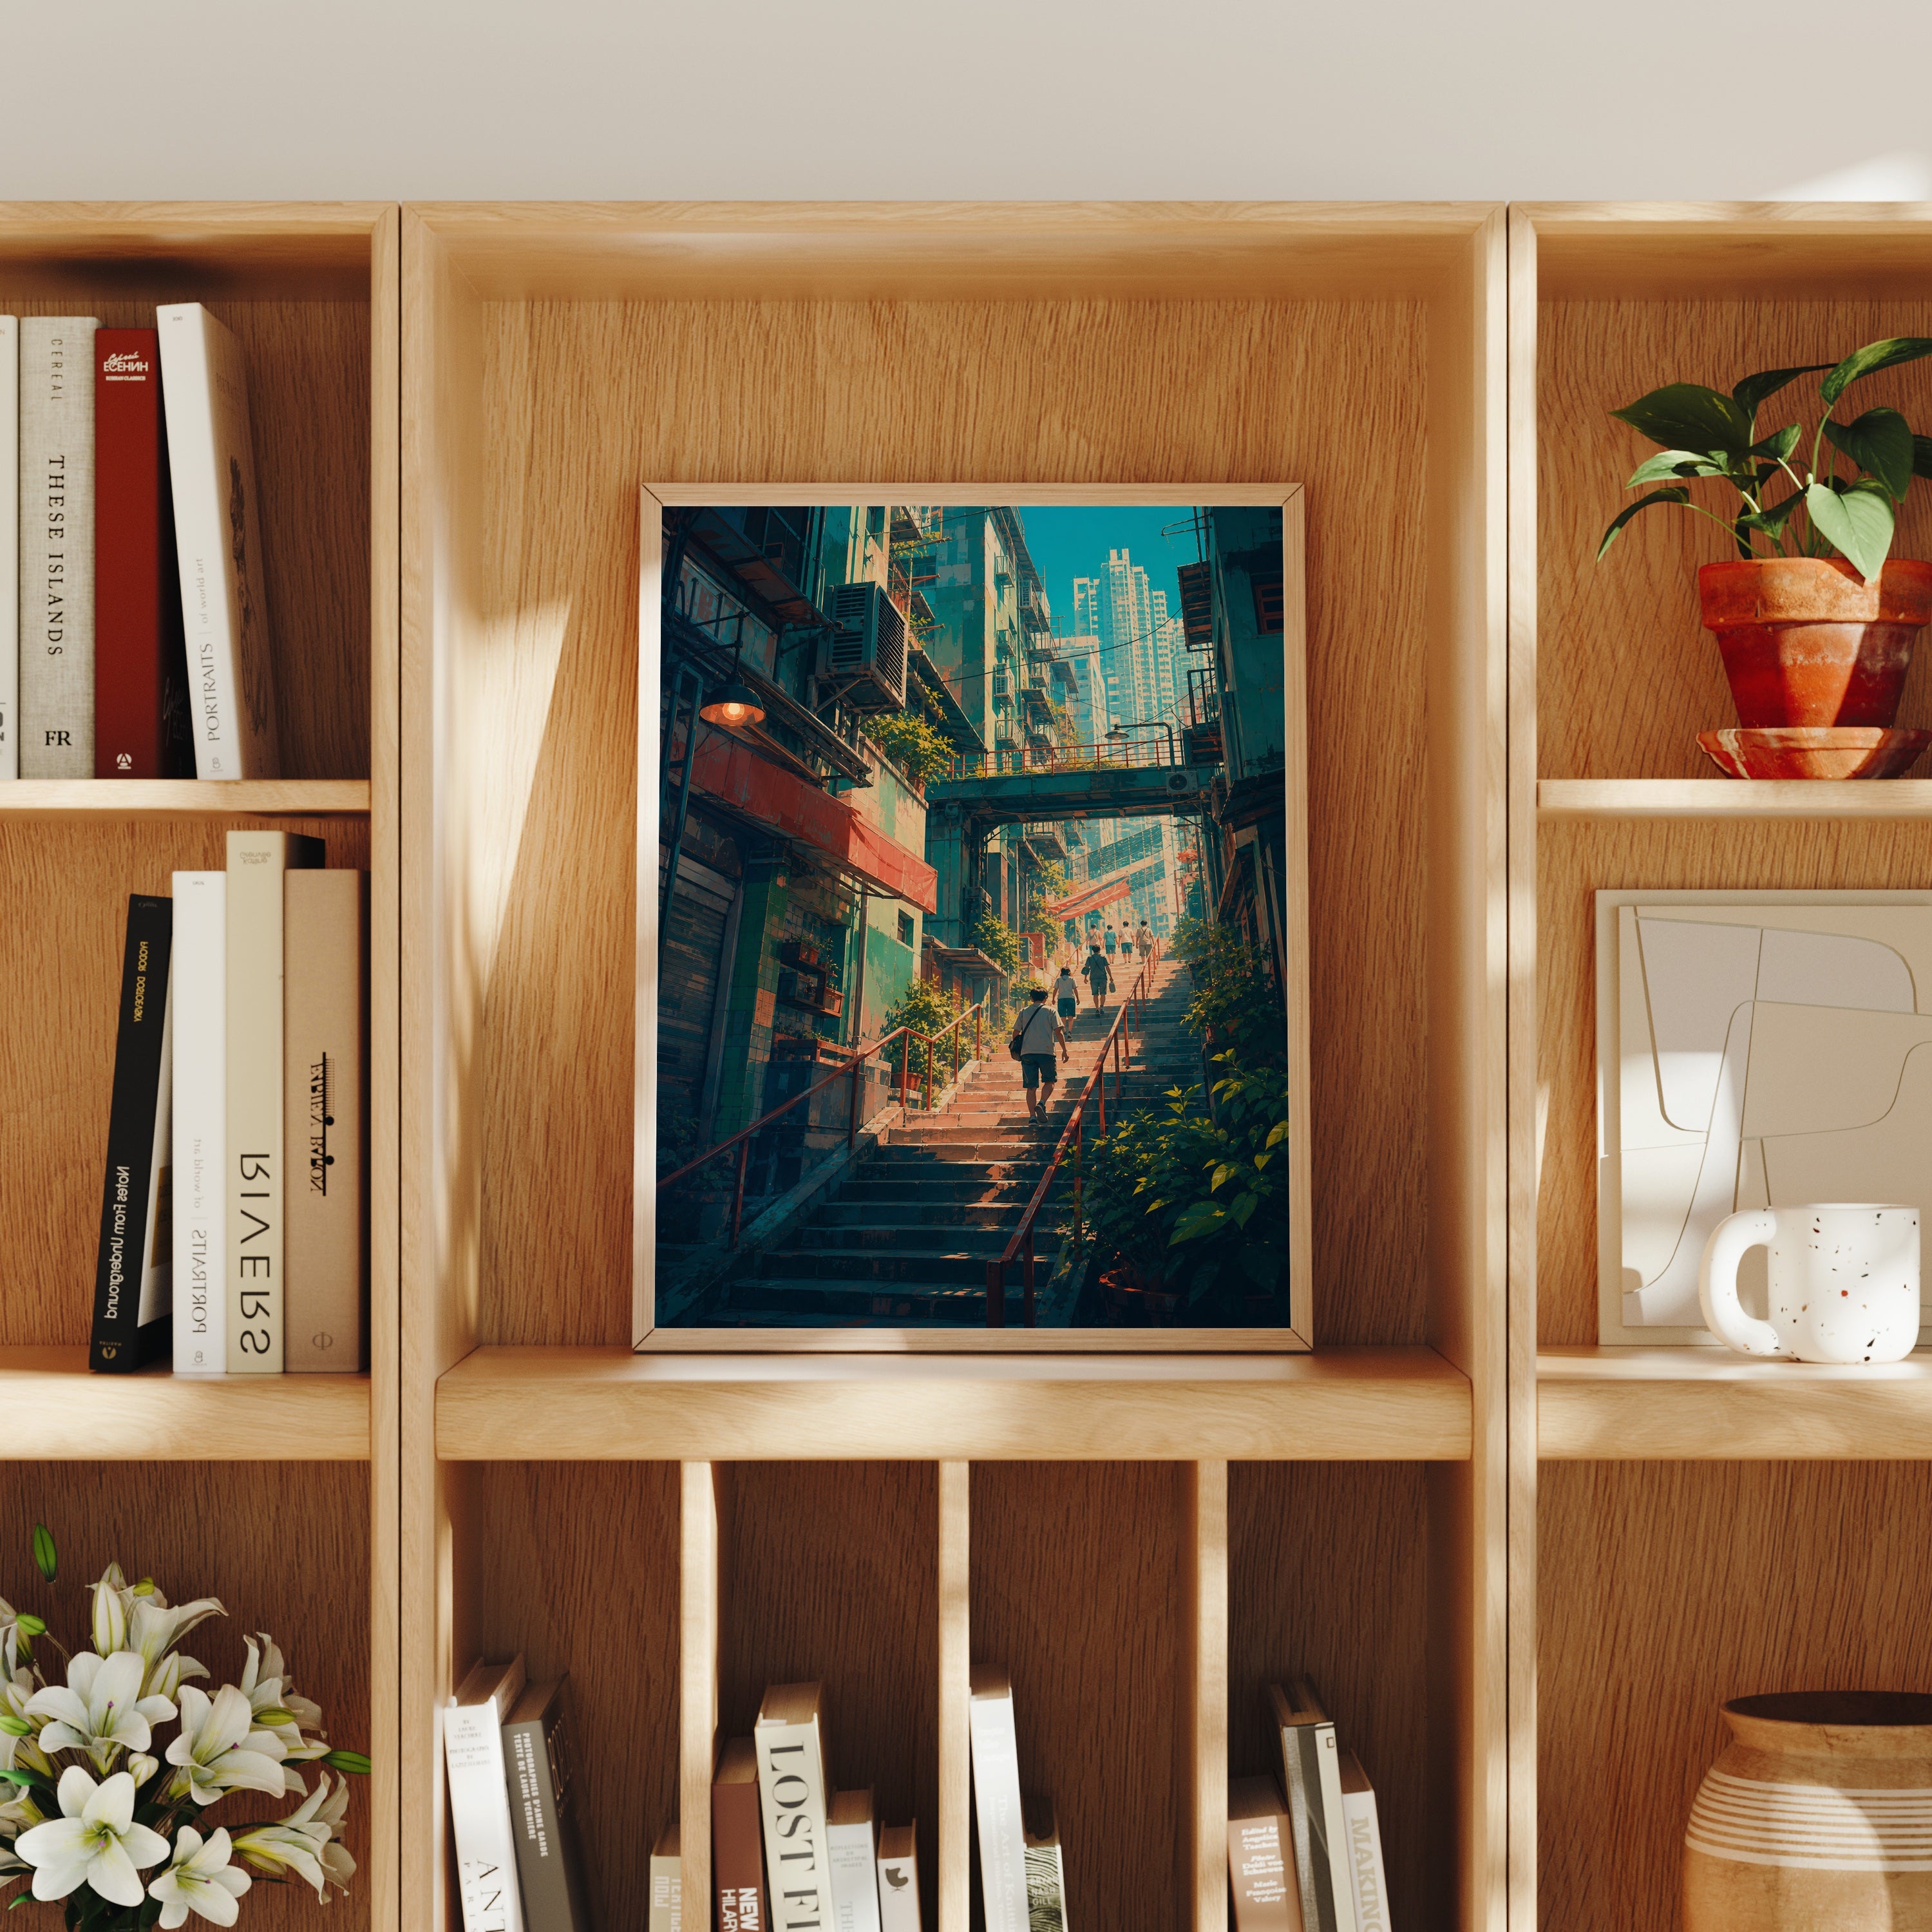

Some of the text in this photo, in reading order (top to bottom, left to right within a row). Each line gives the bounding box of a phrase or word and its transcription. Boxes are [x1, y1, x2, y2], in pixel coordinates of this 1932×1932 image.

[51, 339, 63, 401] CEREAL
[103, 361, 148, 372] ЕСЕНИН
[48, 455, 64, 656] THESE ISLANDS
[195, 558, 204, 573] art
[196, 577, 207, 609] world
[199, 643, 220, 742] PORTRAITS
[45, 731, 72, 746] FR
[513, 1734, 524, 1758] TEXTE
[517, 1760, 526, 1772] DE
[522, 1732, 540, 1797] PHOTOGRAPHIES
[533, 1799, 544, 1829] D'ANNE
[519, 1774, 531, 1799] LAURE
[768, 1741, 817, 1872] LOST
[654, 1875, 670, 1907] NOW
[1032, 1896, 1053, 1906] GILL
[738, 1887, 759, 1931] NEW
